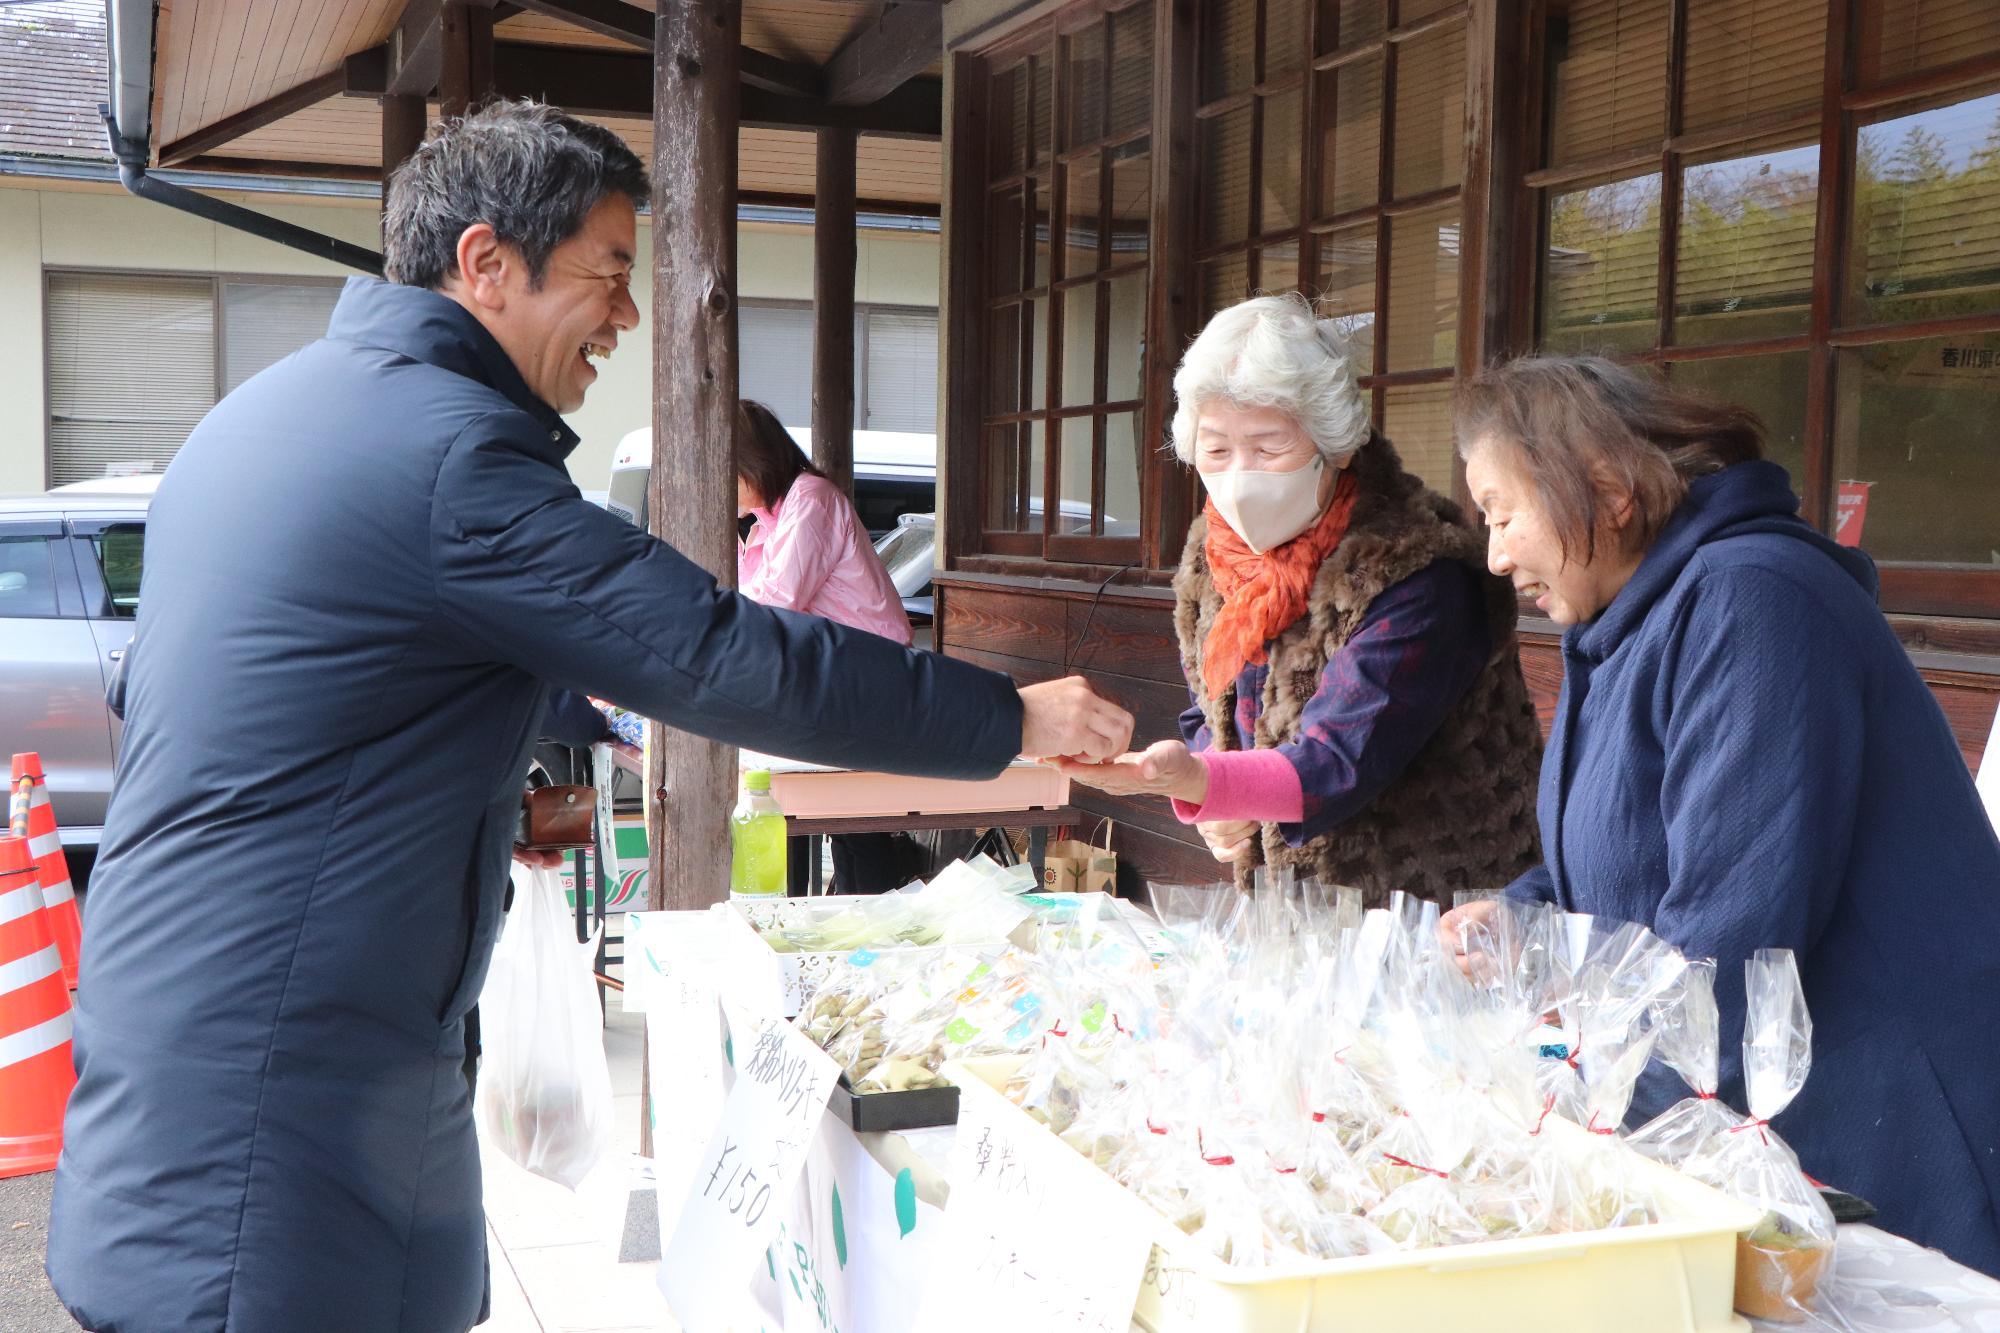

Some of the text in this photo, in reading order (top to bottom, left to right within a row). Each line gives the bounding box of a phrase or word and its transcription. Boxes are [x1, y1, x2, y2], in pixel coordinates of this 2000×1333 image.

[1941, 347, 2000, 369] 香川県
[704, 1136, 771, 1227] ¥150
